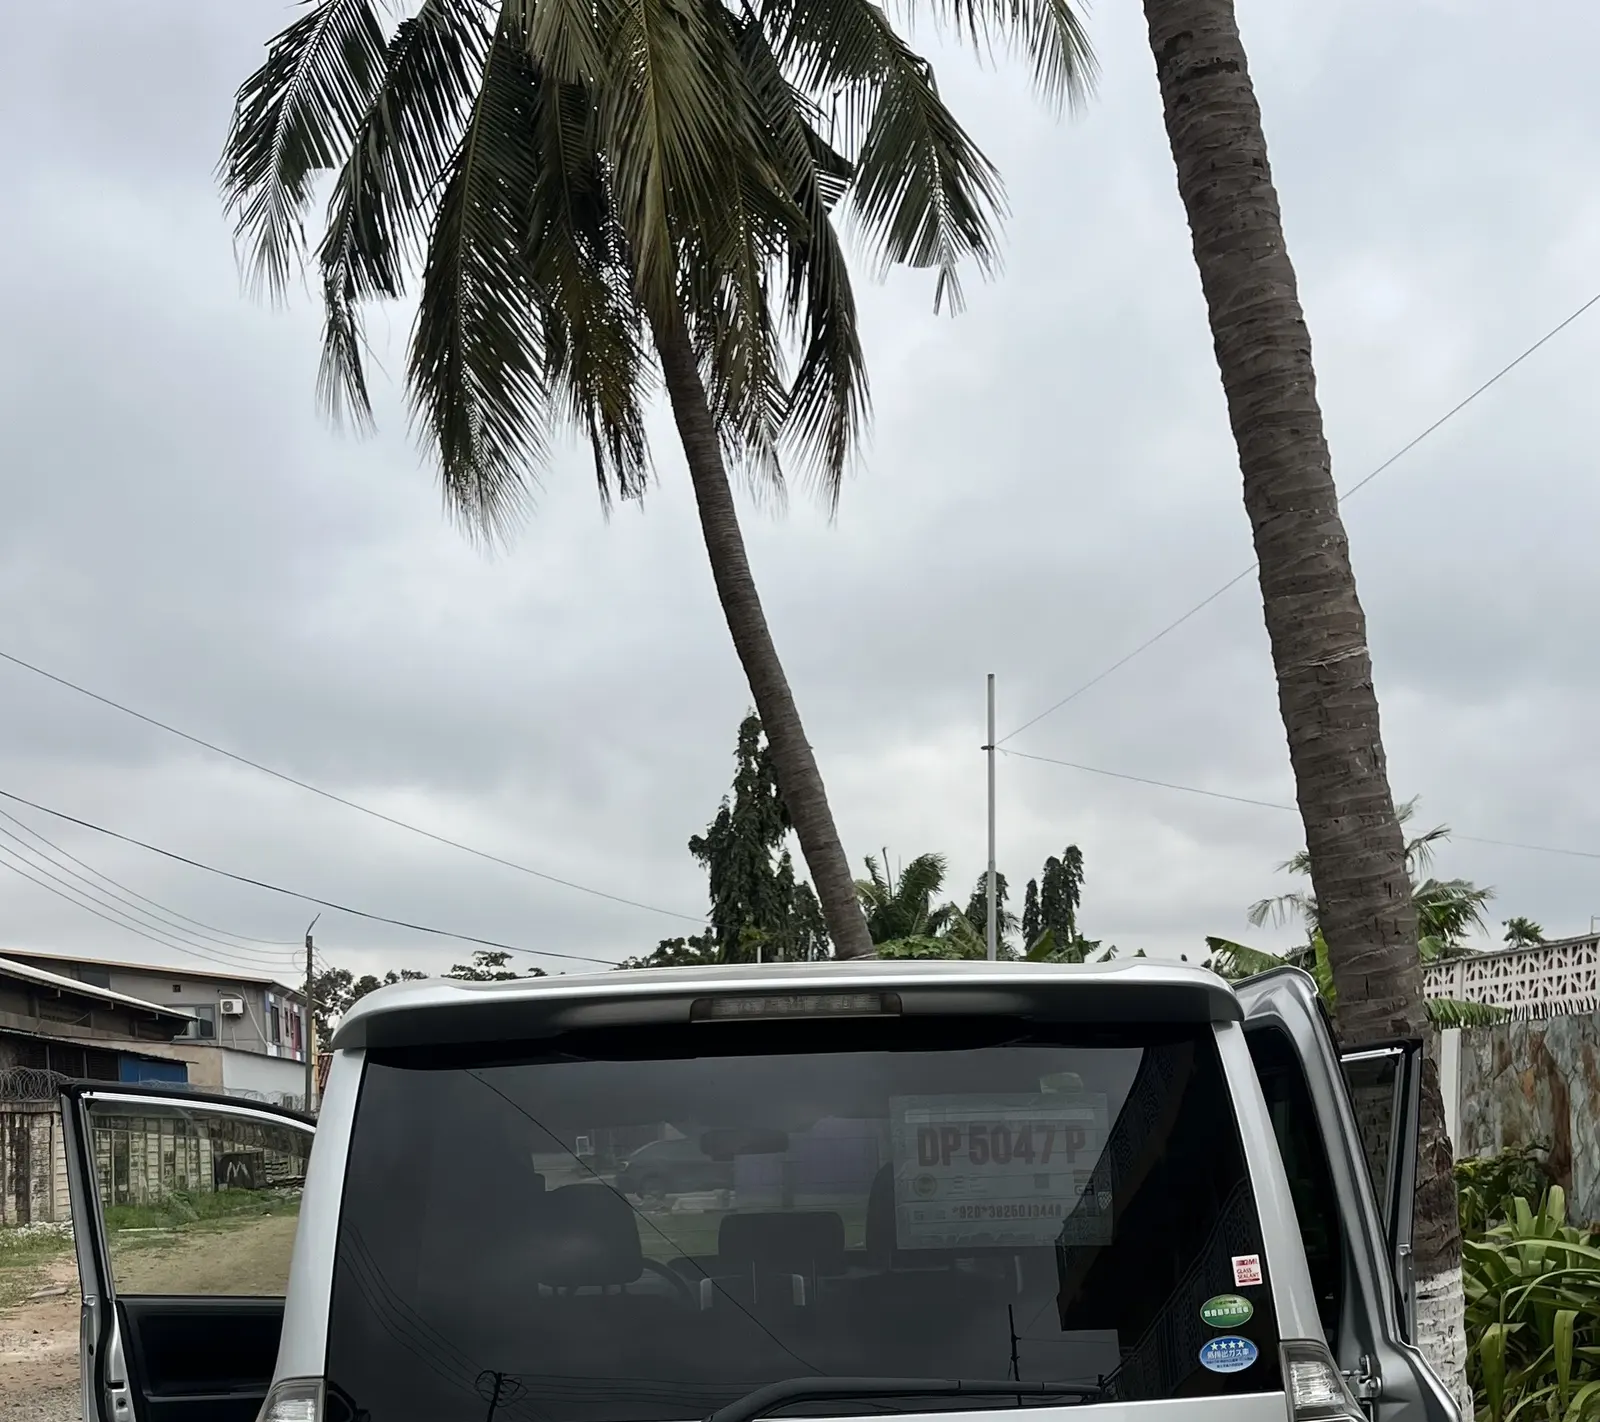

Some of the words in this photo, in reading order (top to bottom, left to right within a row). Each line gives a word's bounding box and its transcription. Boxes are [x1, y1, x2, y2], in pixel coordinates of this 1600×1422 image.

[917, 1126, 962, 1167] DP
[969, 1125, 1056, 1166] 5047
[1065, 1126, 1087, 1164] P
